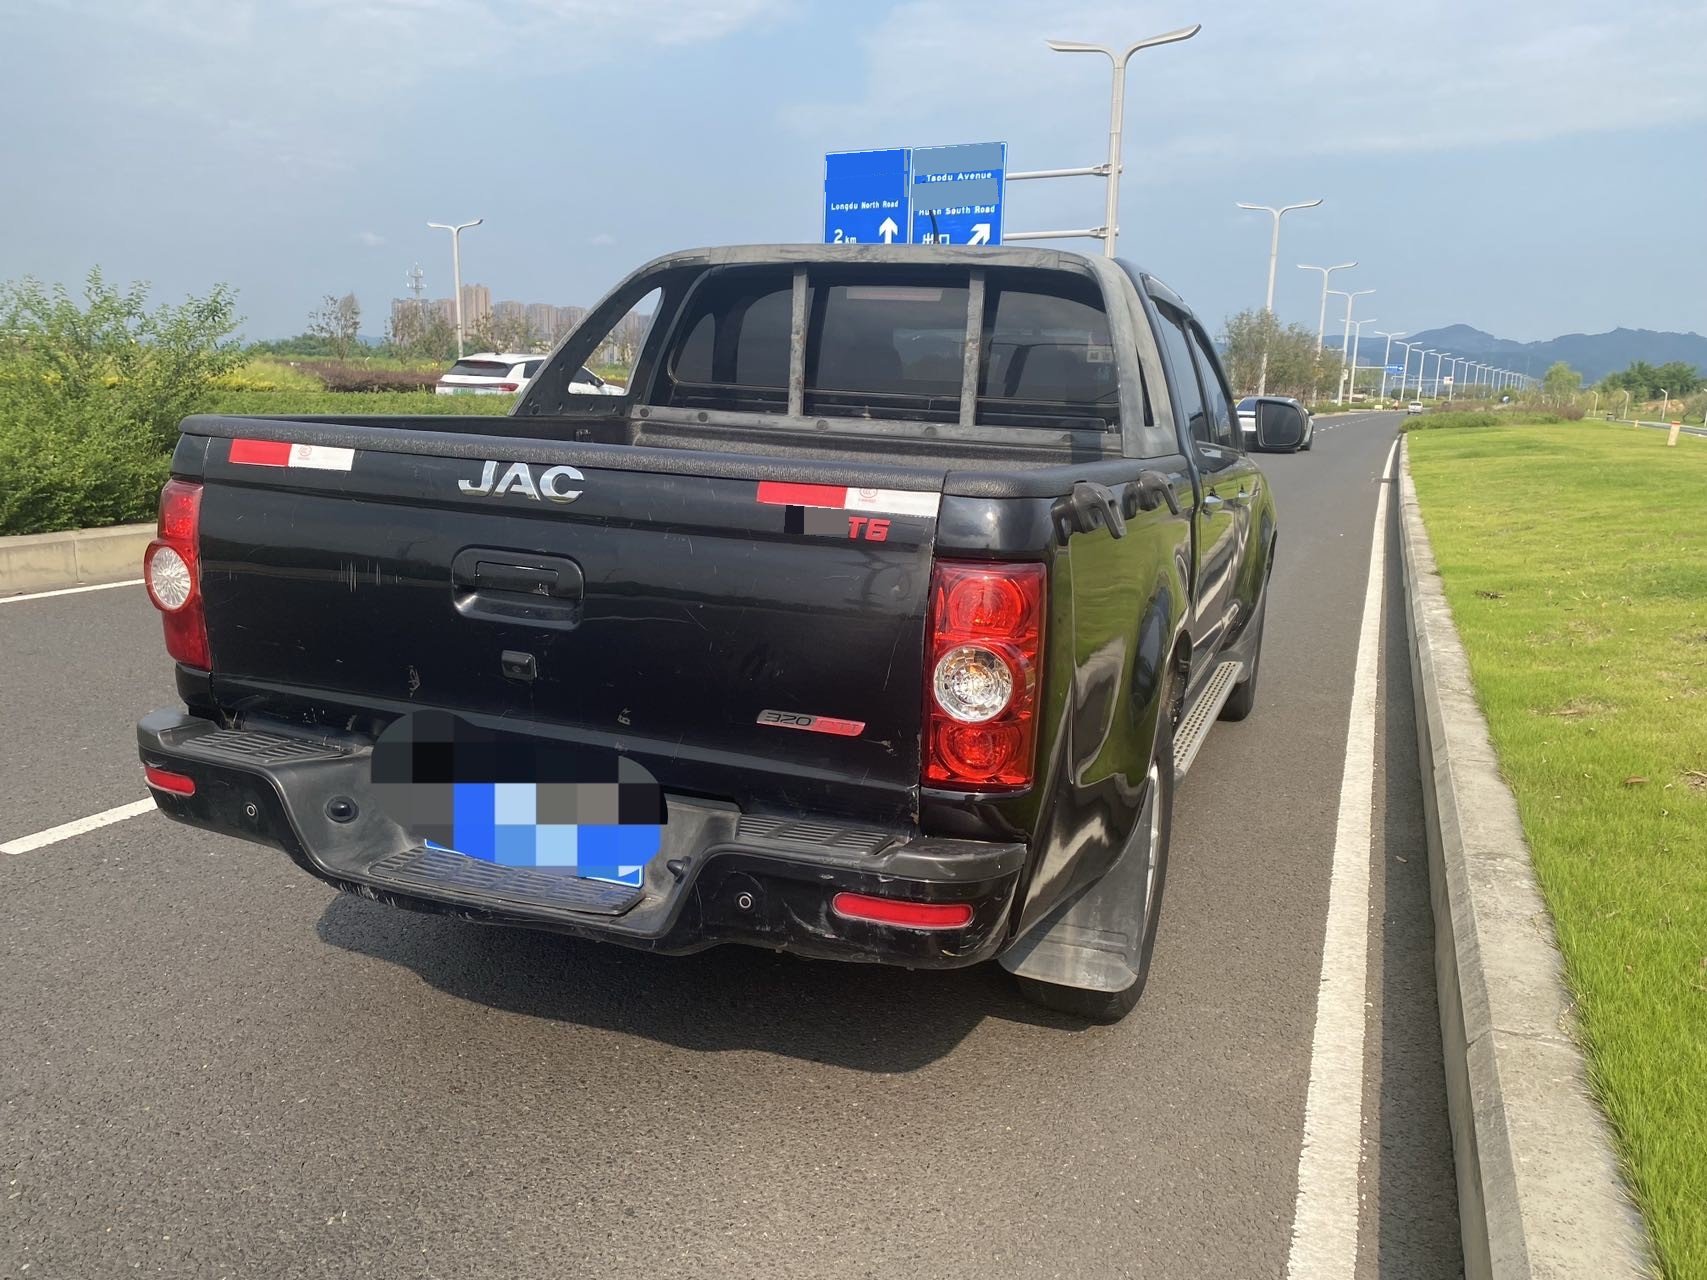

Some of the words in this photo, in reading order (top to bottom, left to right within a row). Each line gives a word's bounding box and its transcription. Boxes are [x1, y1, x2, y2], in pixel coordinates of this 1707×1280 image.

[957, 172, 992, 181] Avenue
[831, 202, 859, 212] Longdu
[861, 201, 880, 209] North
[882, 200, 899, 208] Road
[945, 207, 971, 215] South
[974, 205, 996, 214] Road
[458, 460, 585, 505] JAC
[848, 516, 891, 542] T6
[764, 711, 812, 727] 320
